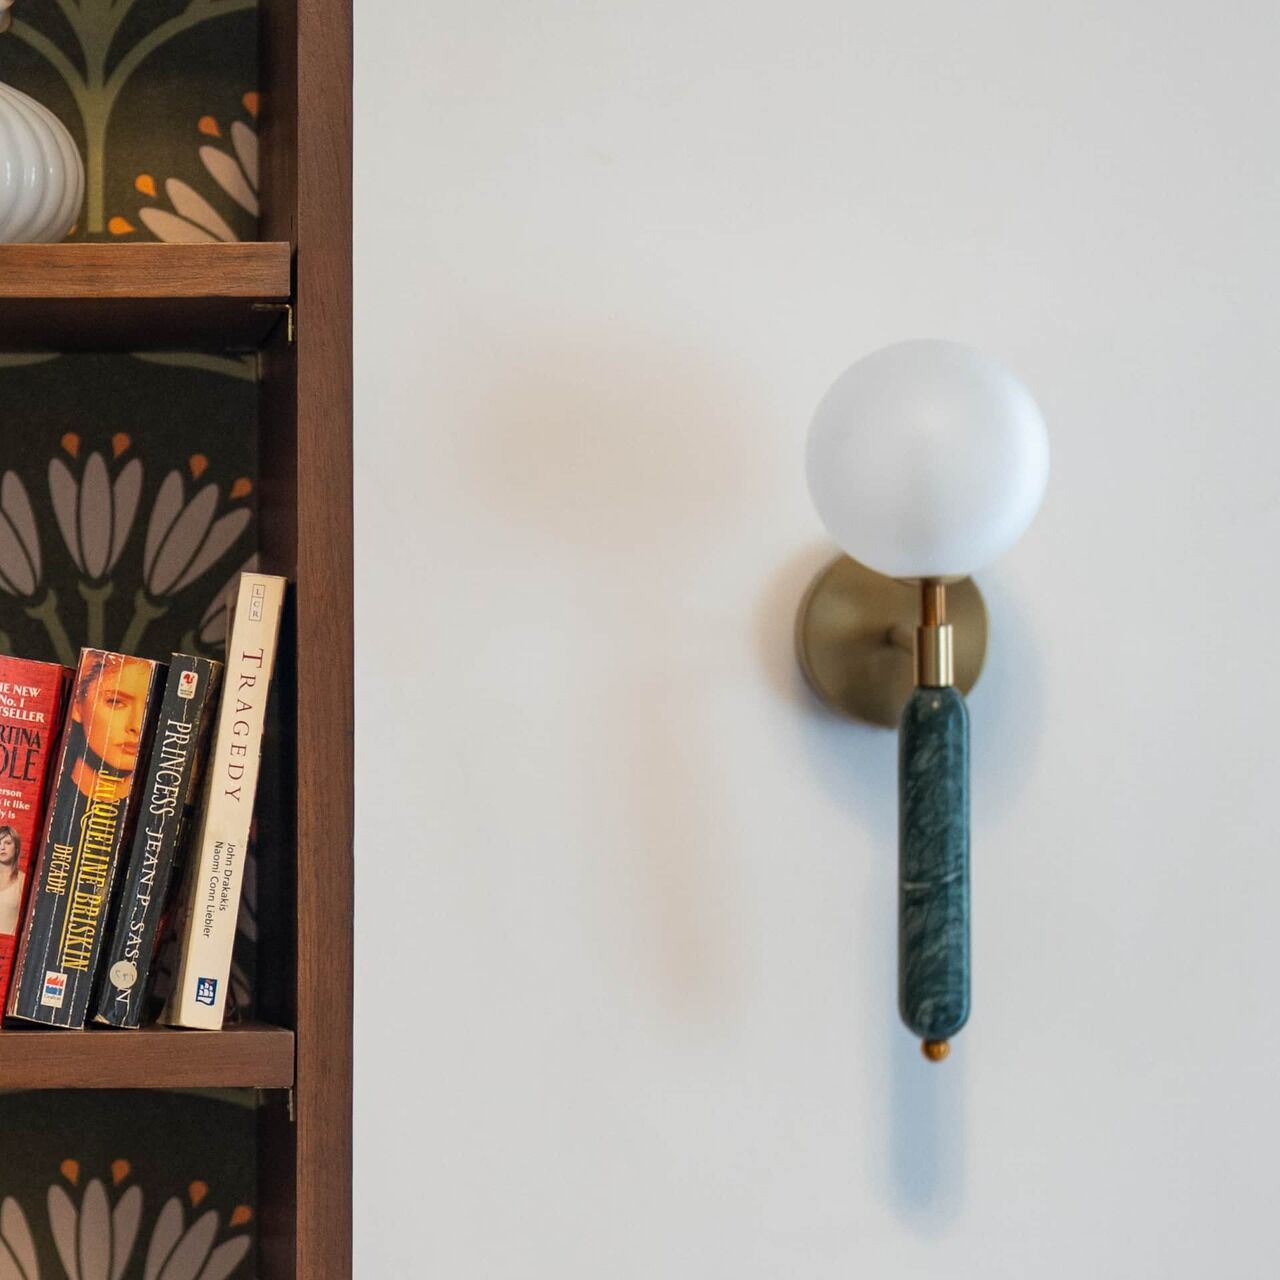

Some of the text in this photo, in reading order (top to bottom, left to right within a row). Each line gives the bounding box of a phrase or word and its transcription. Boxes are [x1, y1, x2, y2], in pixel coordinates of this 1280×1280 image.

[12, 684, 42, 698] NEW
[224, 648, 265, 803] TRAGEDY
[149, 718, 192, 817] PRINCESS
[3, 797, 12, 807] it
[12, 799, 31, 811] like
[8, 809, 16, 819] is
[45, 842, 73, 896] DECADE
[61, 769, 125, 972] JACQUELINE BRISKIN
[141, 826, 164, 887] JEAN
[203, 840, 224, 938] Naomi Conn Liebler
[219, 842, 236, 912] John Drakakis
[115, 921, 145, 1004] SASN
